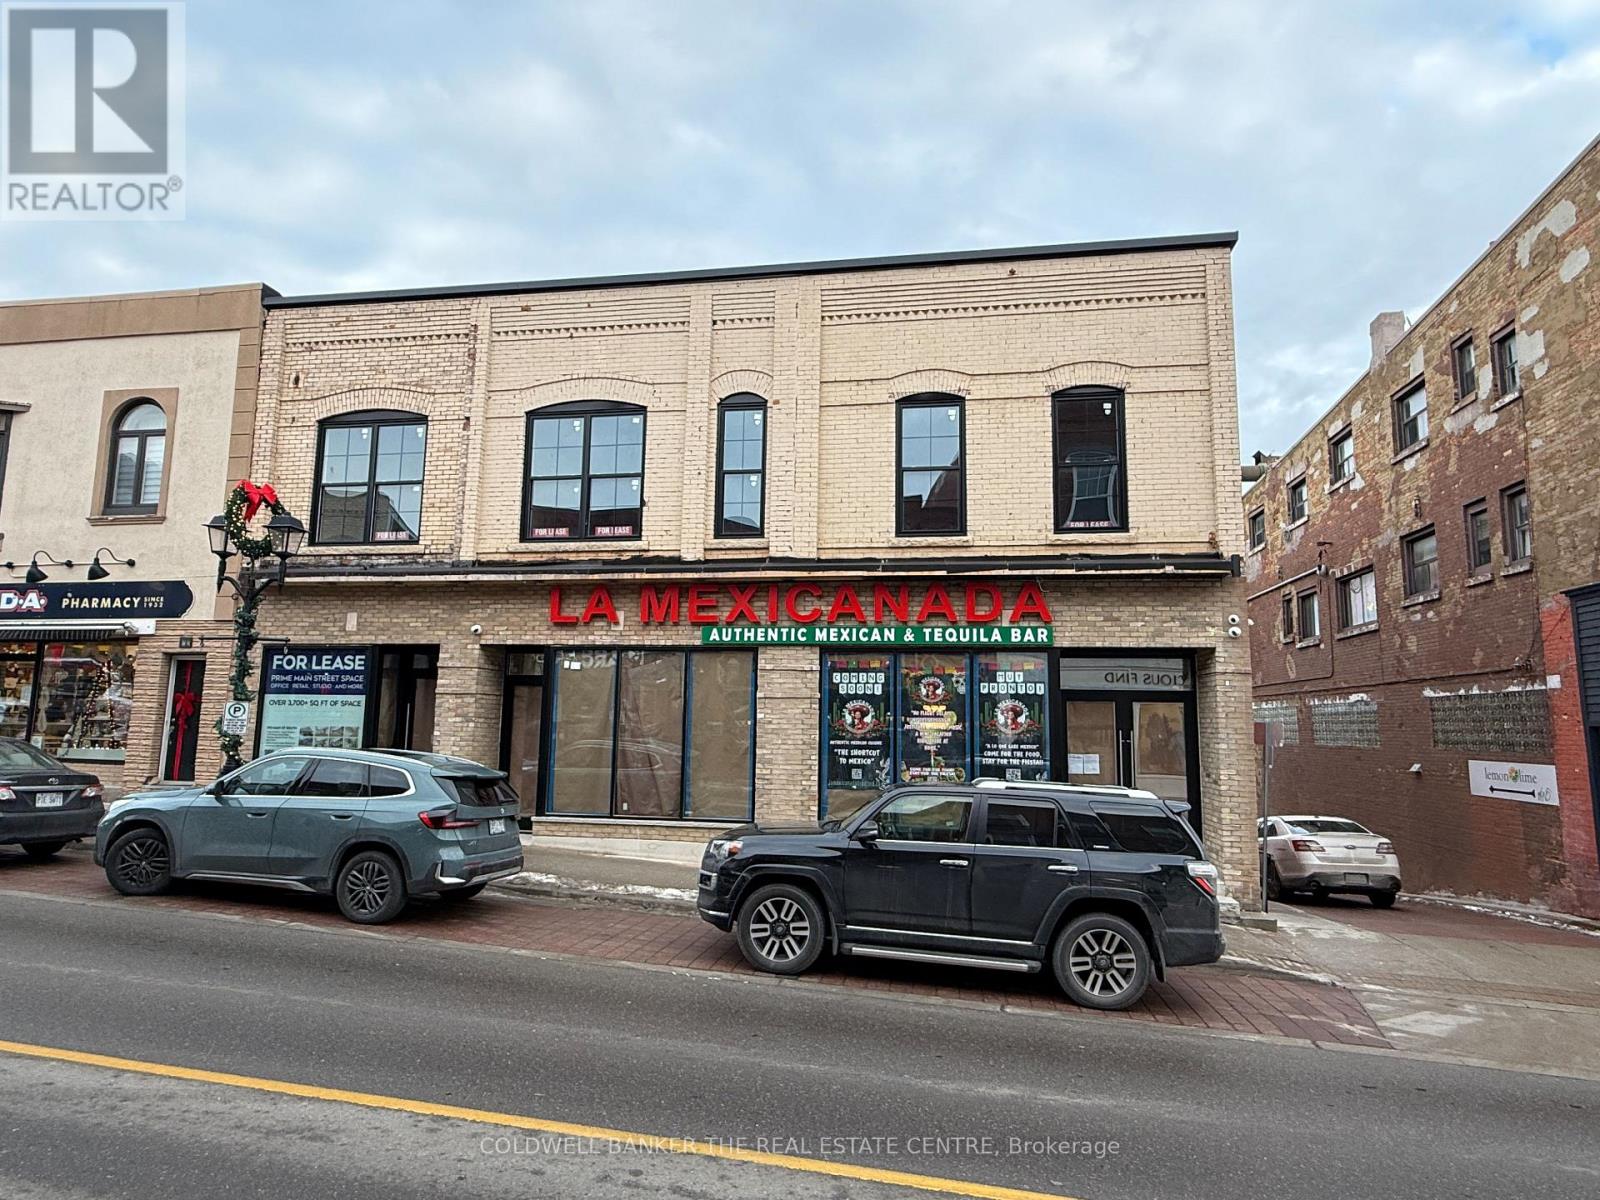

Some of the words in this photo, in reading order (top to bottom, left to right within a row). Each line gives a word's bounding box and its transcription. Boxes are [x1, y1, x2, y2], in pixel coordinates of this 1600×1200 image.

[62, 597, 141, 608] PHARMACY
[550, 584, 620, 624] LA
[640, 582, 1053, 624] MEXICANADA
[709, 628, 807, 641] AUTHENTIC
[815, 628, 895, 642] MEXICAN
[903, 628, 915, 642] &
[923, 628, 1002, 642] TEQUILA
[1011, 628, 1048, 642] BAR
[272, 655, 307, 670] FOR
[311, 655, 366, 670] LEASE
[833, 673, 884, 683] COMING
[233, 706, 242, 715] P
[1484, 767, 1509, 781] lemon
